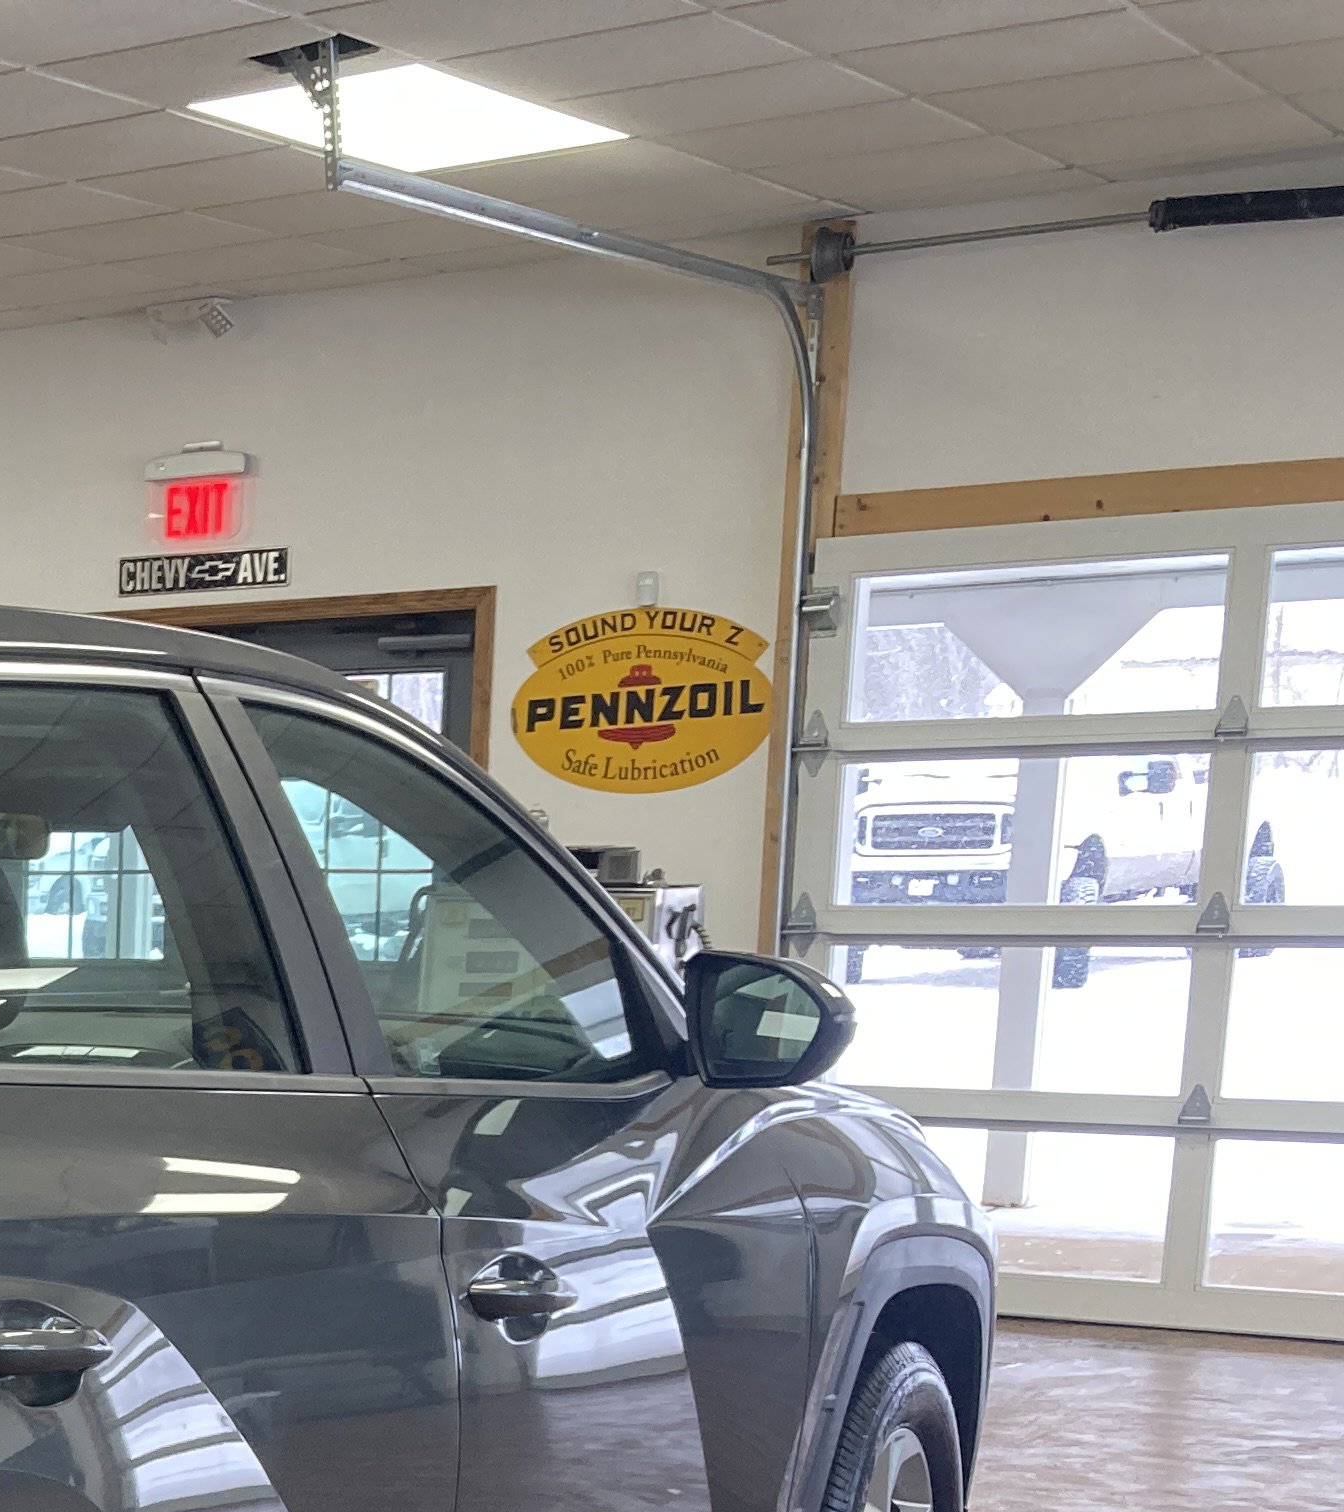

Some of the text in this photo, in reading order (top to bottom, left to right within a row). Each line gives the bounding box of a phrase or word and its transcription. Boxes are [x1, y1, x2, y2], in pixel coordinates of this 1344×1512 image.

[166, 482, 229, 539] EXIT
[121, 551, 286, 592] CHEVY AVE.
[549, 610, 744, 653] SOUND YOUR Z
[558, 644, 729, 680] 100% Pure Pennsylvania
[525, 679, 765, 733] PENNZOIL
[561, 747, 721, 781] Safe Lubrication
